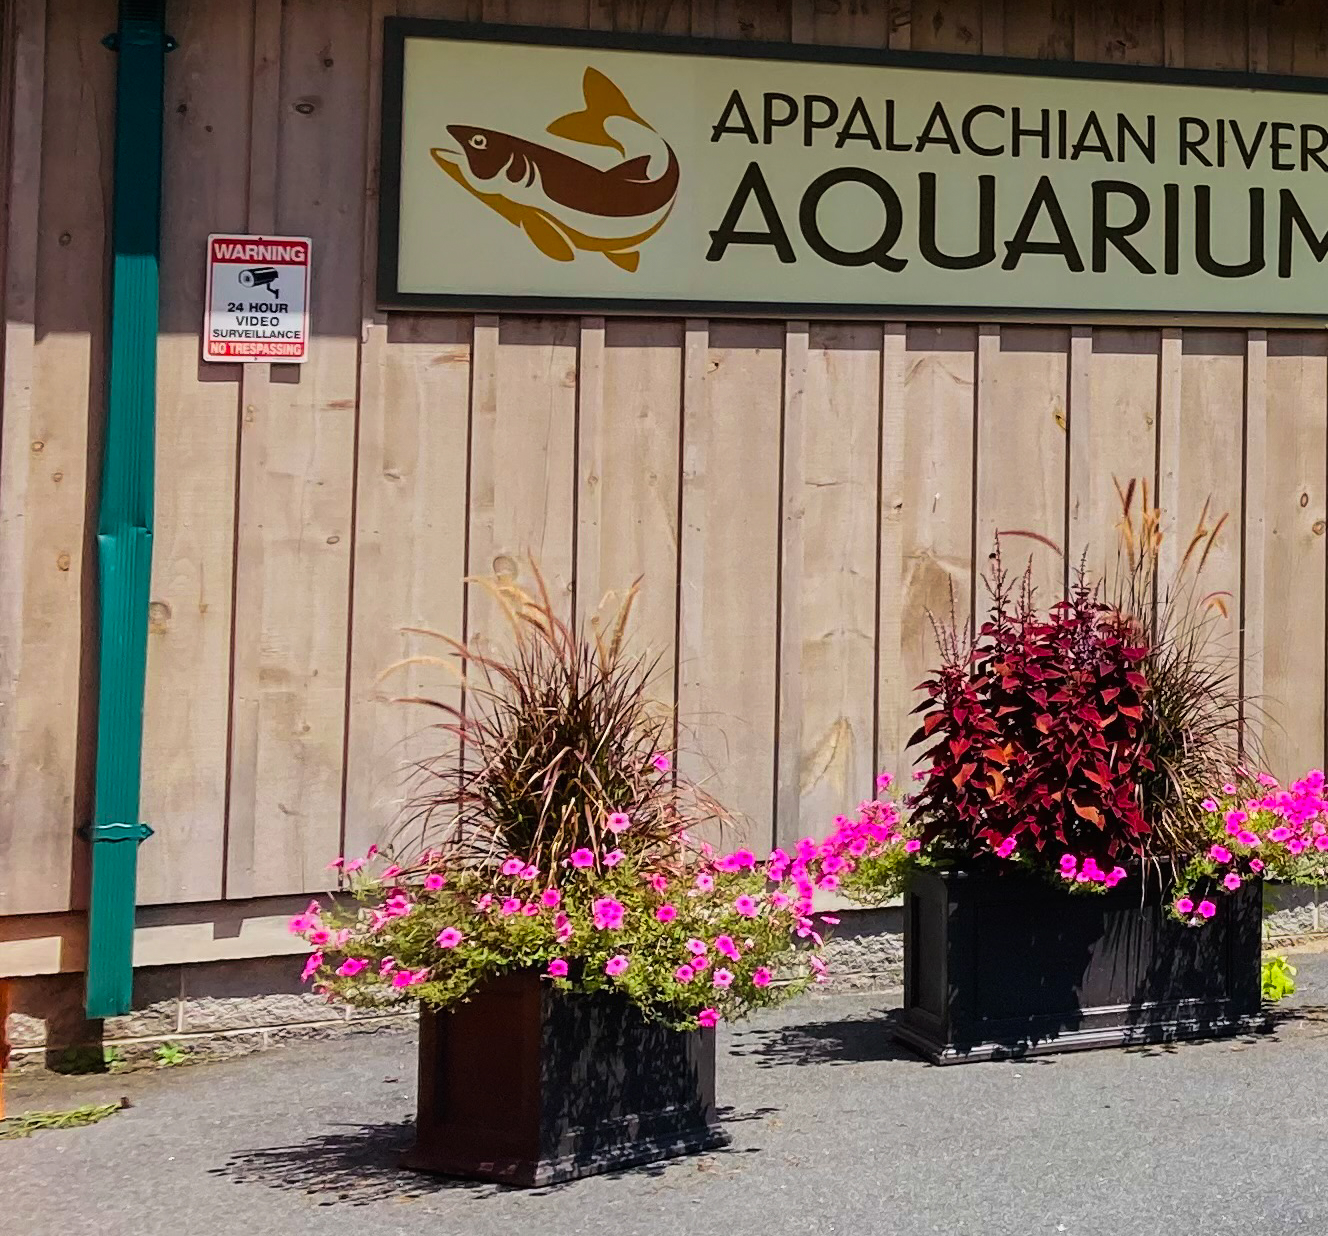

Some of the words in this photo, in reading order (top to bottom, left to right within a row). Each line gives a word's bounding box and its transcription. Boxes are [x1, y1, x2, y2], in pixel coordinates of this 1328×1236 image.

[711, 89, 1155, 164] APPALACHIAN
[214, 243, 305, 262] WARNING
[227, 302, 244, 313] 24
[248, 302, 289, 314] HOUR
[235, 316, 280, 327] VIDEO
[212, 328, 302, 339] SURVEILLANCE
[210, 342, 227, 354] NO
[230, 342, 302, 356] TRESPASSING
